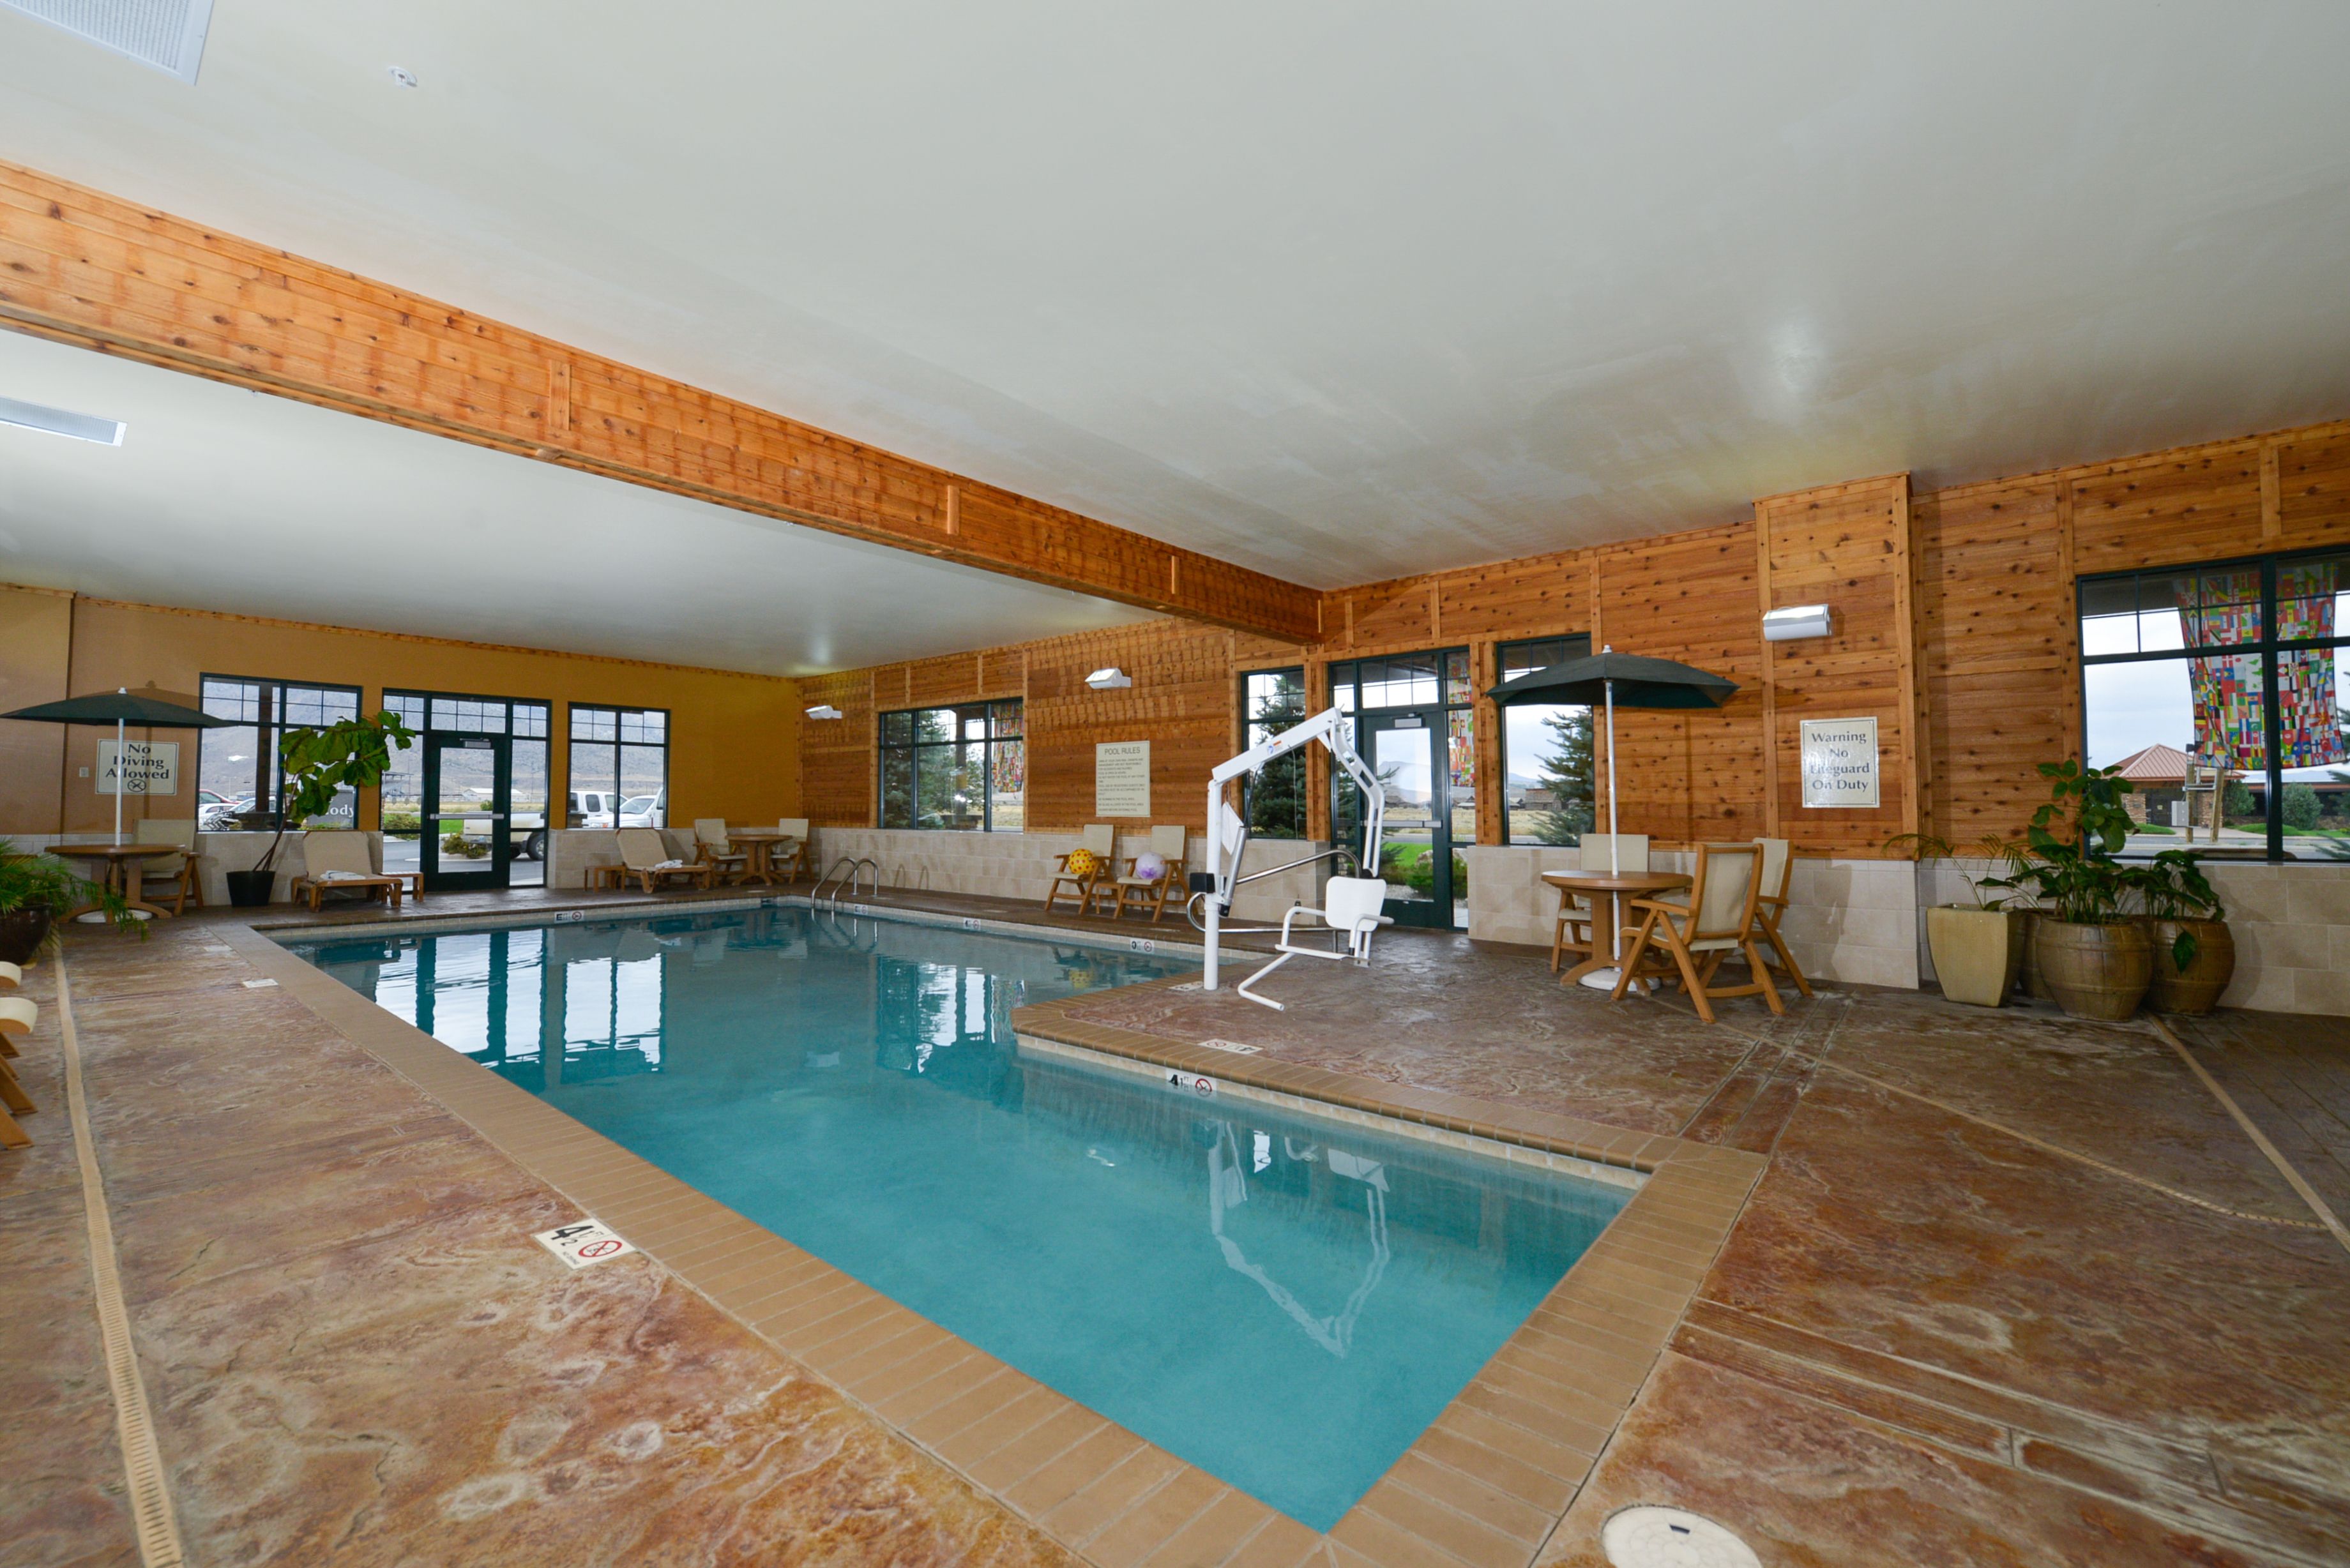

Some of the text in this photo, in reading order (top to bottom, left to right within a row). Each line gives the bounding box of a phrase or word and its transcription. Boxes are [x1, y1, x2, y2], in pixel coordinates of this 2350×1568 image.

[1811, 731, 1867, 744] Warning
[128, 744, 151, 754] No
[1121, 746, 1140, 755] RULES
[1830, 748, 1849, 758] No
[114, 755, 164, 769] Diving
[105, 767, 169, 779] Alowed
[1810, 762, 1870, 777] Lifeguard
[1812, 780, 1869, 792] On Duty
[326, 804, 354, 818] ody
